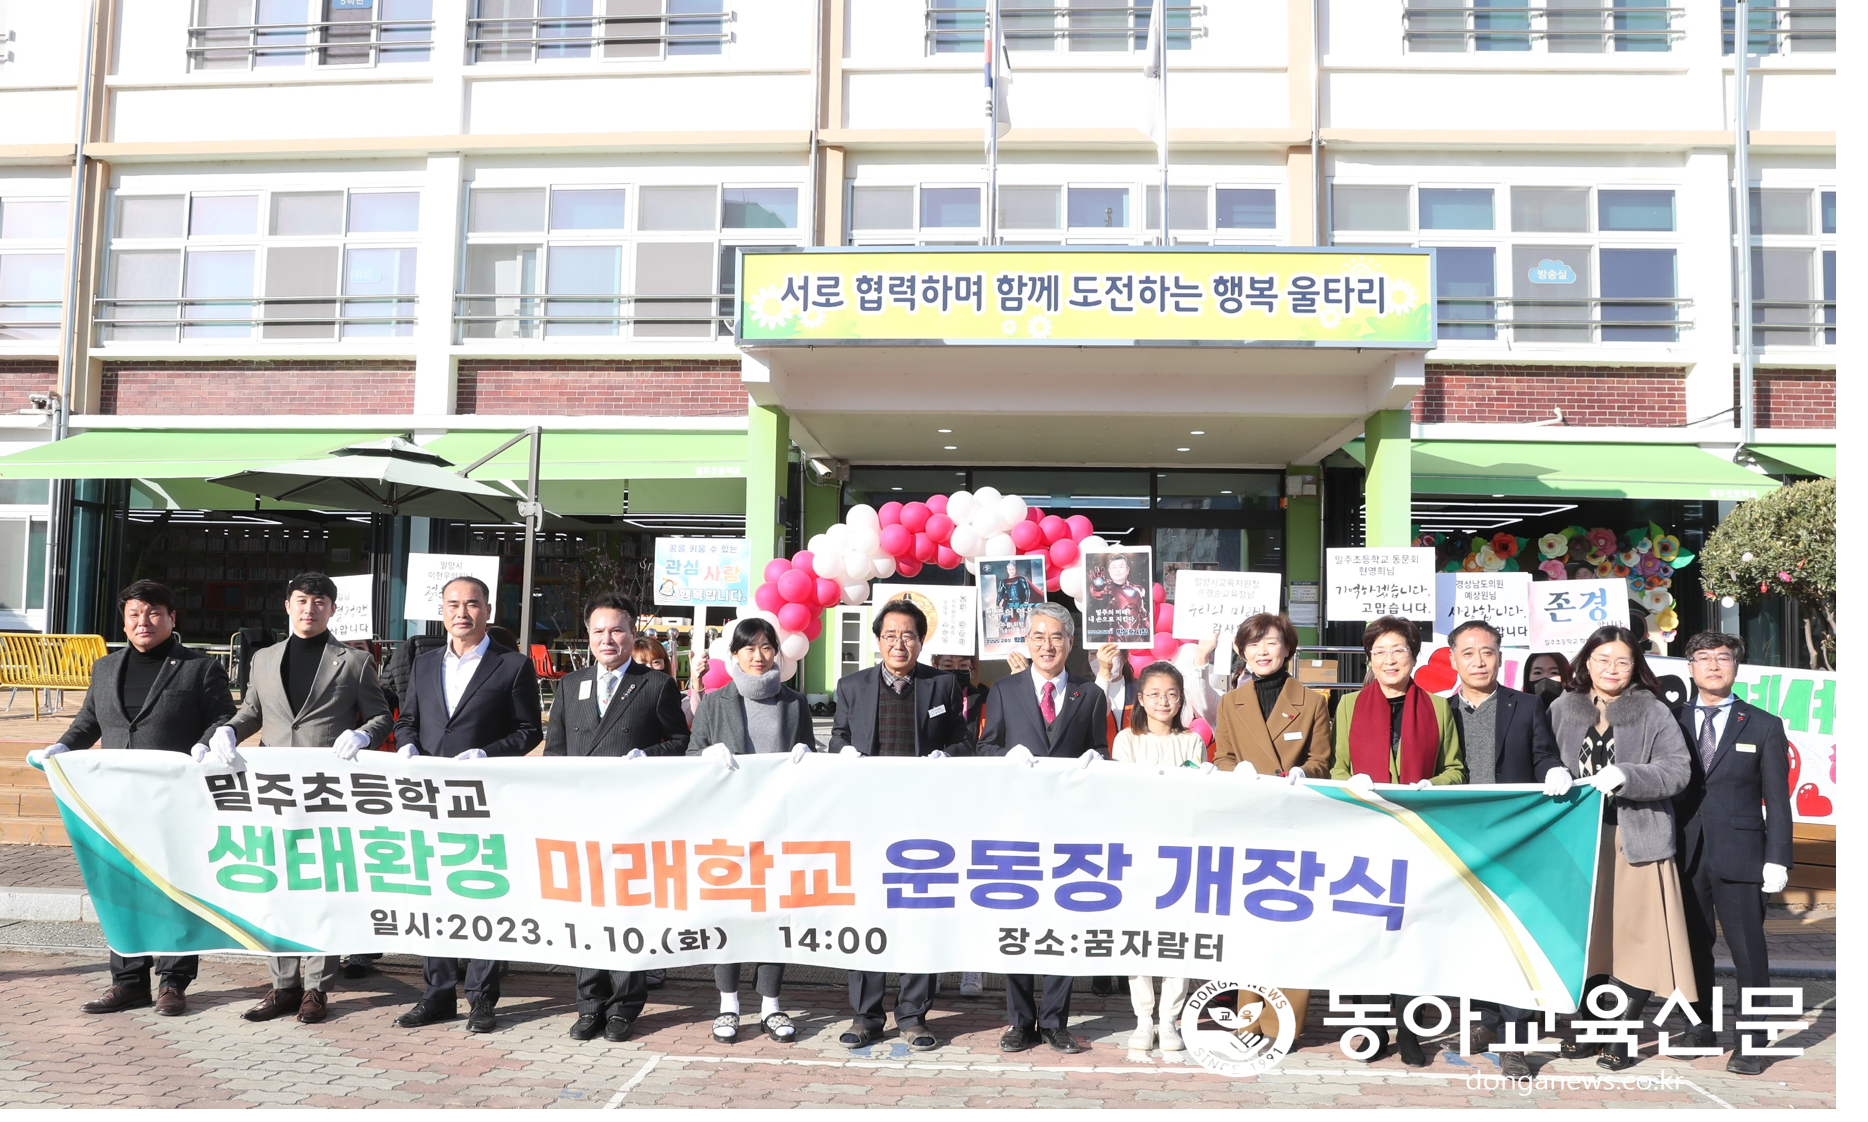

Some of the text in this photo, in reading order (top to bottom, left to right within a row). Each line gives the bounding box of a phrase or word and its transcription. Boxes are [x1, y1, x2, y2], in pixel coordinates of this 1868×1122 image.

[1537, 269, 1567, 280] 방송실
[780, 274, 1385, 315] 서로 협력하며 함께 도전하는 행복 울타리
[669, 545, 685, 553] 꿈을
[709, 545, 717, 553] 수
[721, 545, 737, 554] 있는
[1335, 554, 1419, 565] 밀주초등학교 동문회
[665, 559, 740, 582] 관심 사랑
[1359, 566, 1395, 576] 현영희님
[1194, 577, 1260, 589] 밀양시교육지원청
[1456, 579, 1504, 590] 경상남도의원
[679, 588, 747, 602] 행복합니다.
[1197, 589, 1255, 600] 손경순교육장님
[1464, 591, 1497, 600] 예상원님
[1188, 603, 1224, 618] 우리의
[1361, 602, 1431, 615] 고맙습니다.
[1543, 588, 1608, 622] 존경
[1212, 622, 1242, 634] 감사
[204, 770, 491, 820] 밀주초등학교
[207, 823, 1409, 932] 생태환경 미래학교 운동장 개장식
[369, 907, 555, 948] 일시:2023.
[777, 925, 889, 958] 14:00
[998, 927, 1225, 963] 장소:꿈자람터
